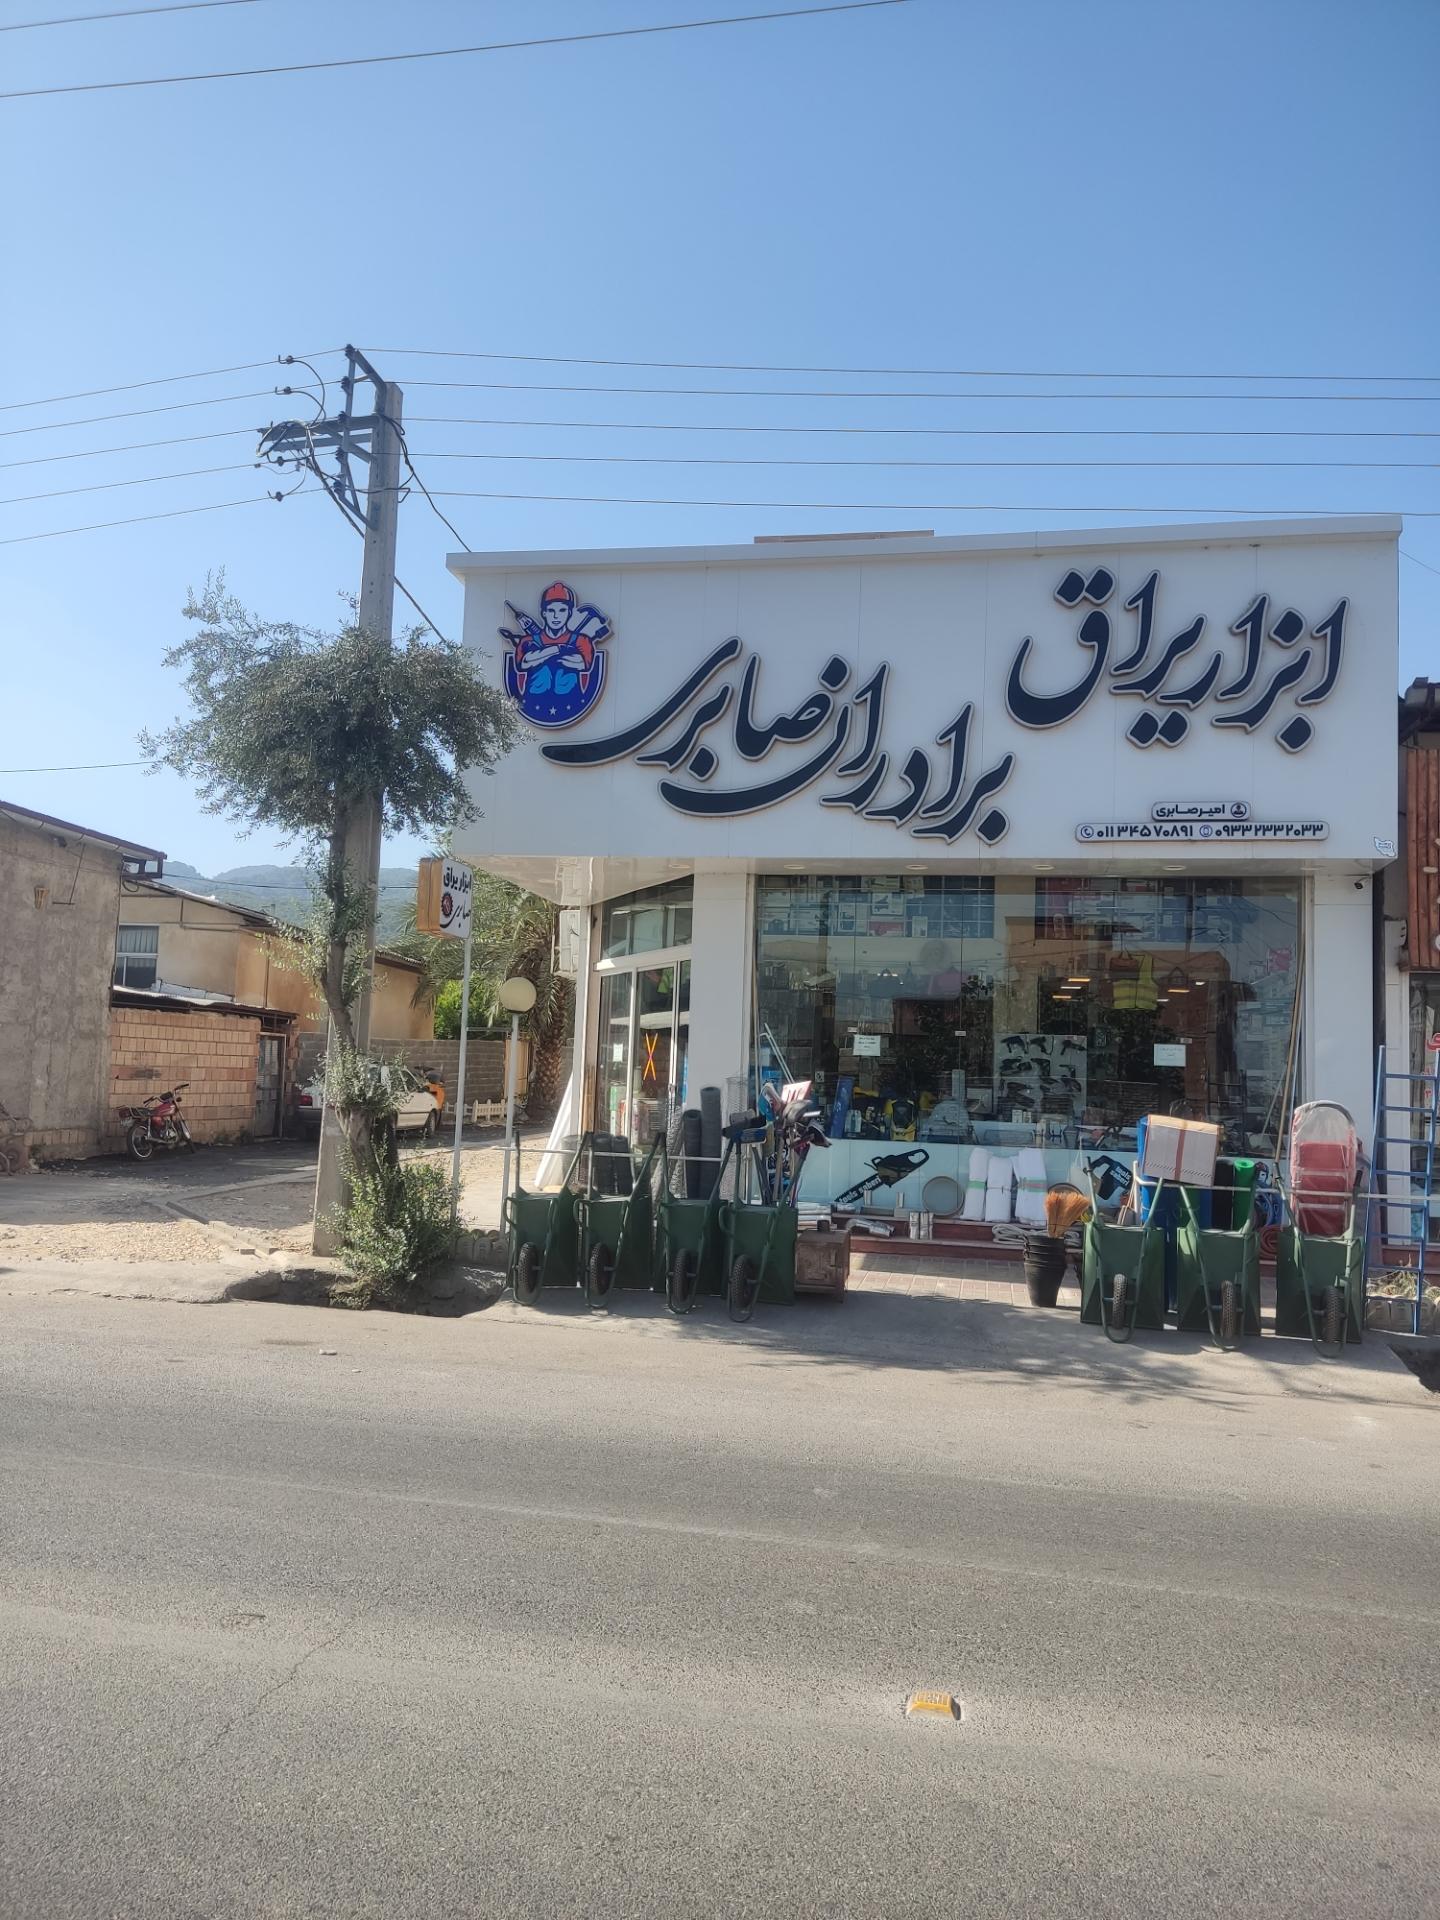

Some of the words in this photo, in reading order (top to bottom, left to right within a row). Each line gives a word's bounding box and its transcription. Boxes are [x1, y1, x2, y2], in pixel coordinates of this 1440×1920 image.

[539, 635, 837, 782] صابری
[1004, 566, 1208, 749] یراق
[1157, 593, 1351, 754] ابزار
[656, 660, 1016, 846] برادران
